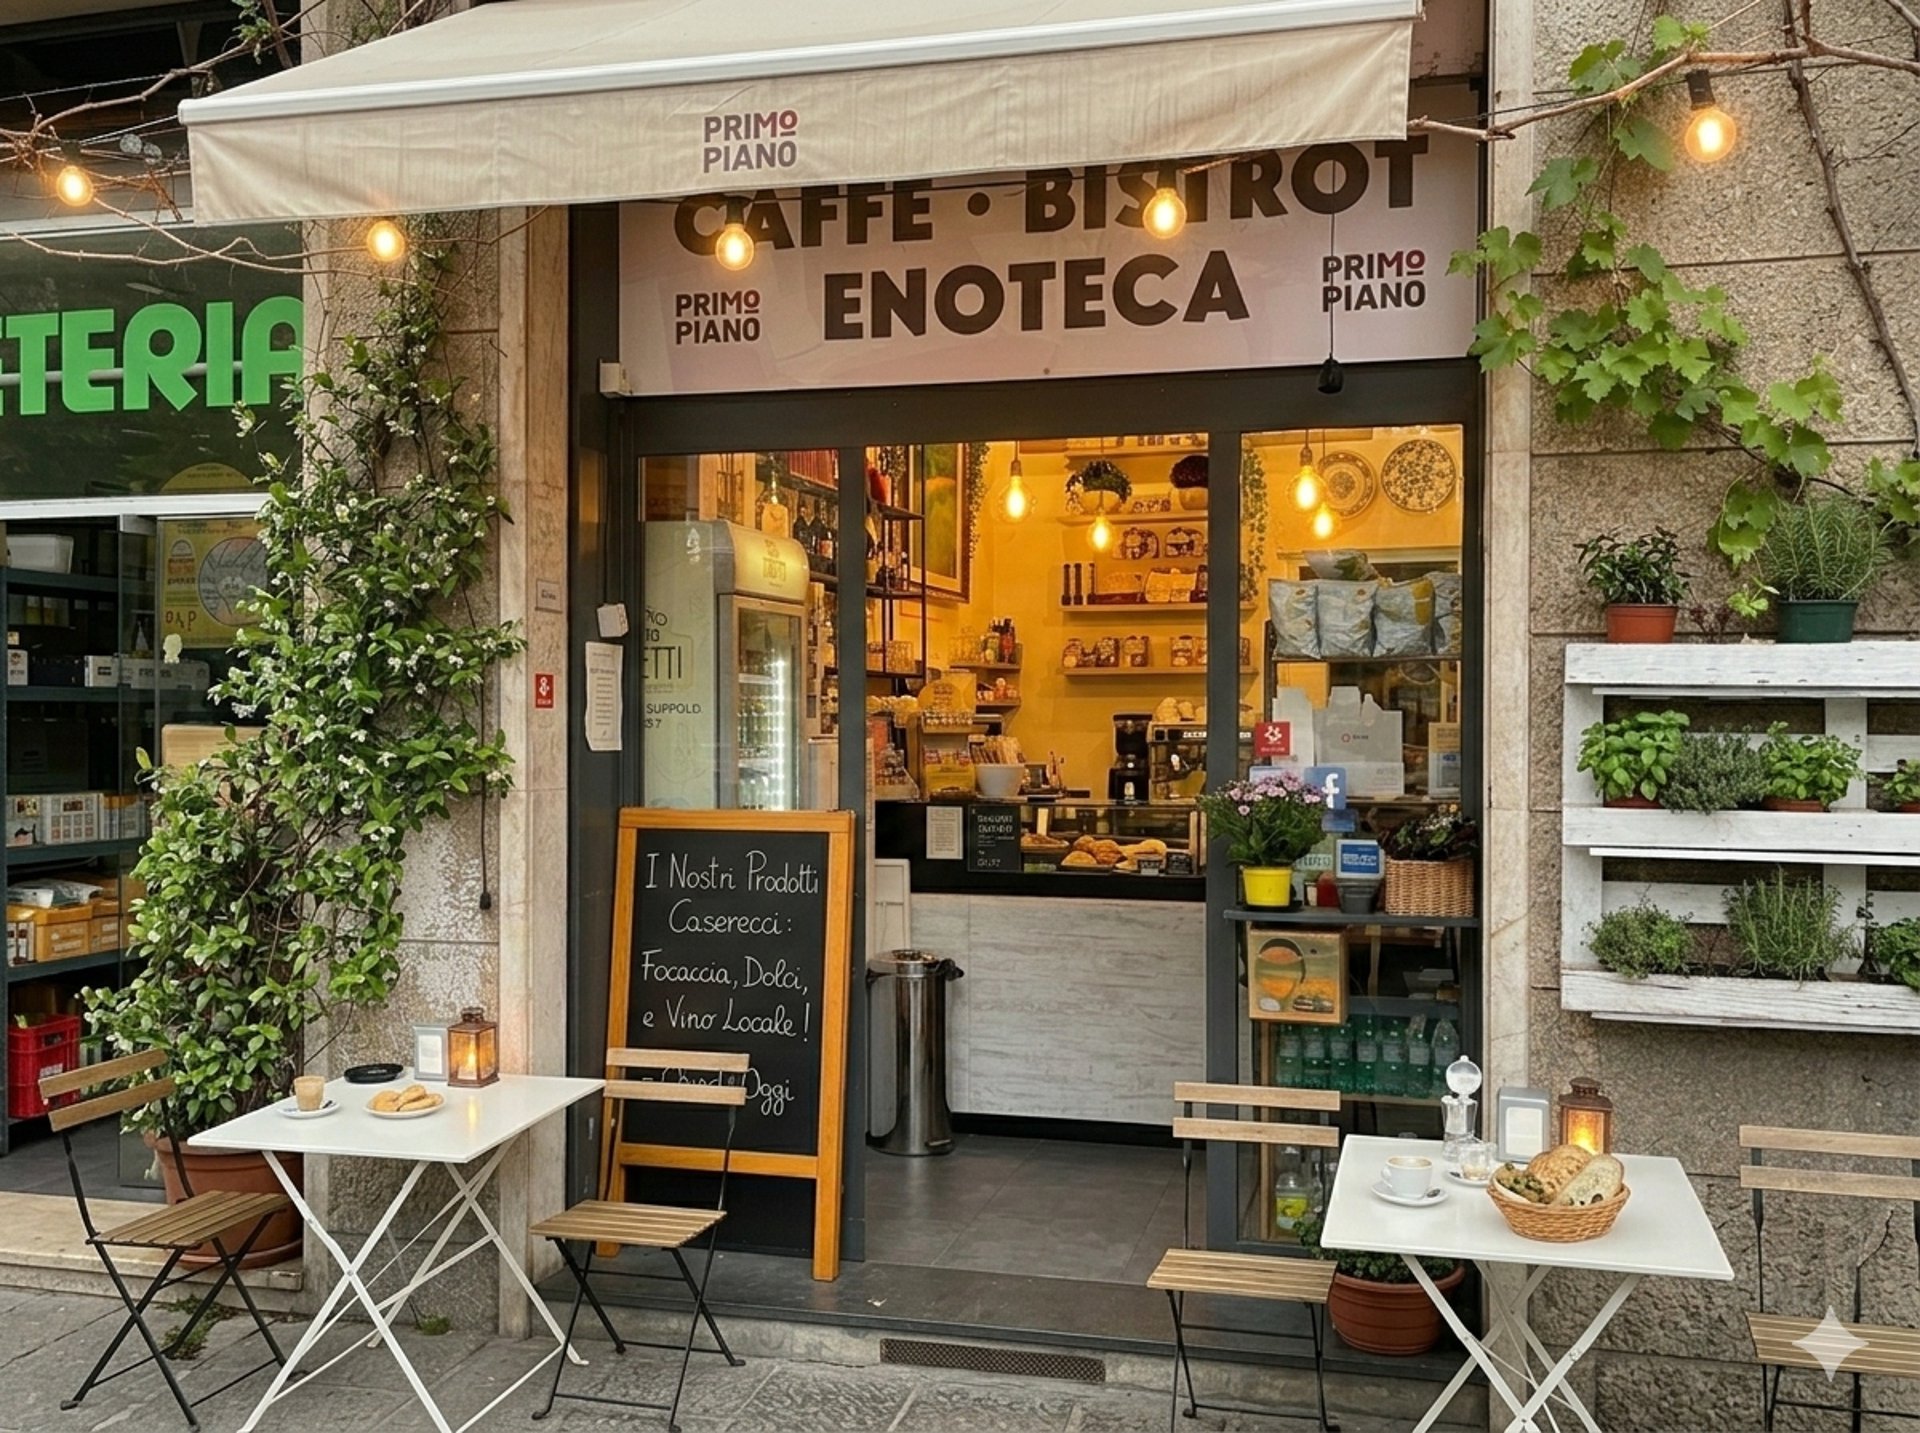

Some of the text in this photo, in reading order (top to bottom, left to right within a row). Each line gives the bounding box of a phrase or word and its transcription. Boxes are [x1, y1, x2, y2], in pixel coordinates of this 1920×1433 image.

[703, 140, 797, 173] PIANO
[824, 250, 1250, 340] ENOTECA
[1322, 280, 1426, 313] PIANO
[676, 317, 761, 345] PIANO
[0, 295, 304, 416] TERIA
[645, 850, 819, 894] I Nostri Prodotti
[641, 949, 809, 995] Focaccia, Dolci,
[642, 1011, 656, 1028] e
[665, 995, 718, 1030] Vino
[742, 1067, 795, 1116] Oggi
